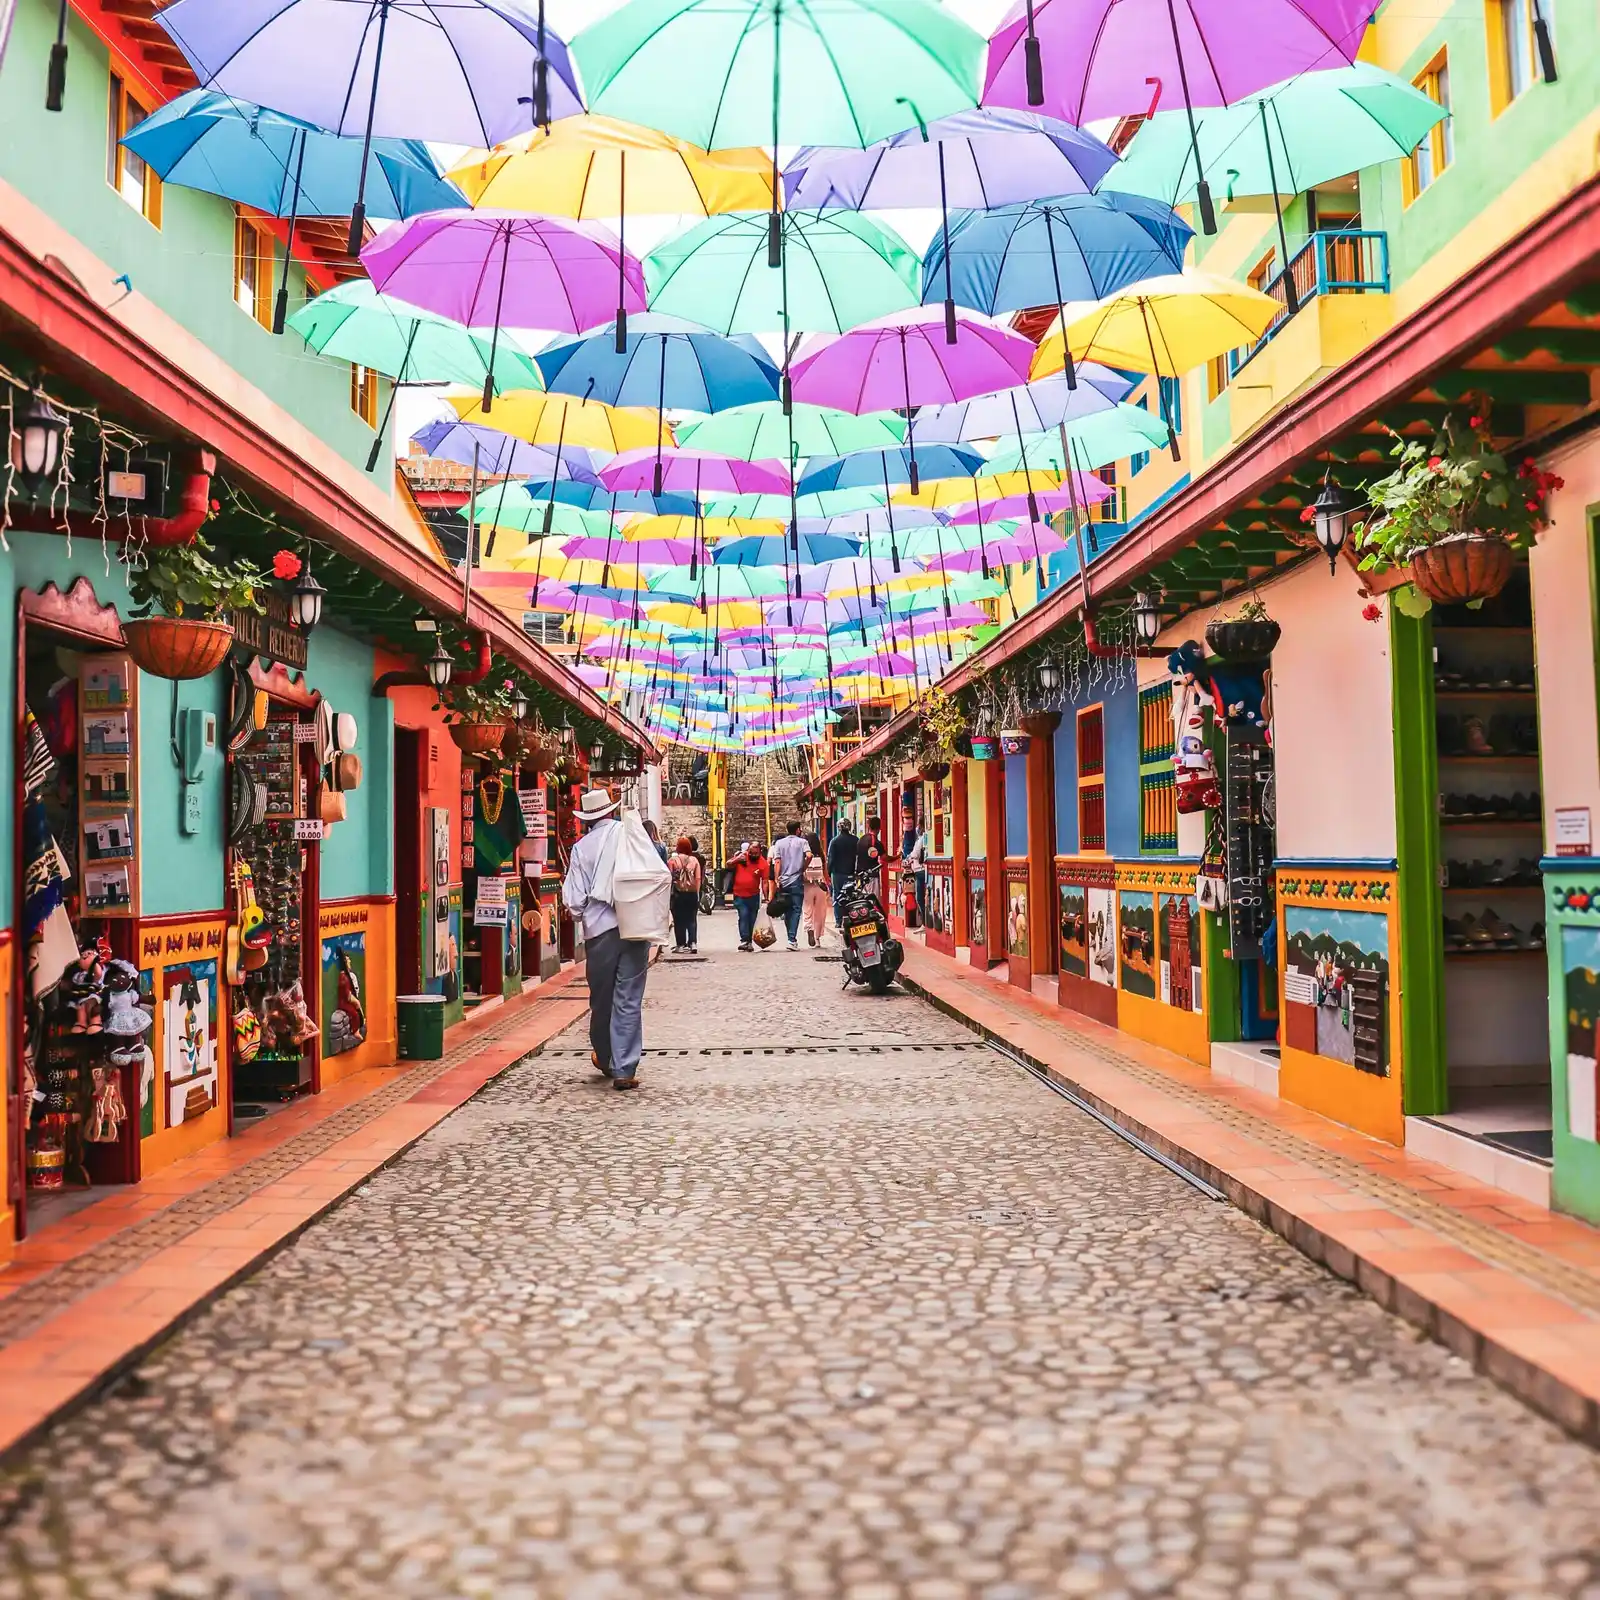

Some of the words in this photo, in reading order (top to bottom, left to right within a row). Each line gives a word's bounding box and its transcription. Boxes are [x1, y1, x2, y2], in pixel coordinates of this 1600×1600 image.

[232, 609, 262, 649] DULCE
[269, 625, 306, 664] RECUERDO
[300, 821, 305, 829] 3
[313, 821, 318, 830] $
[297, 831, 321, 839] 10.000
